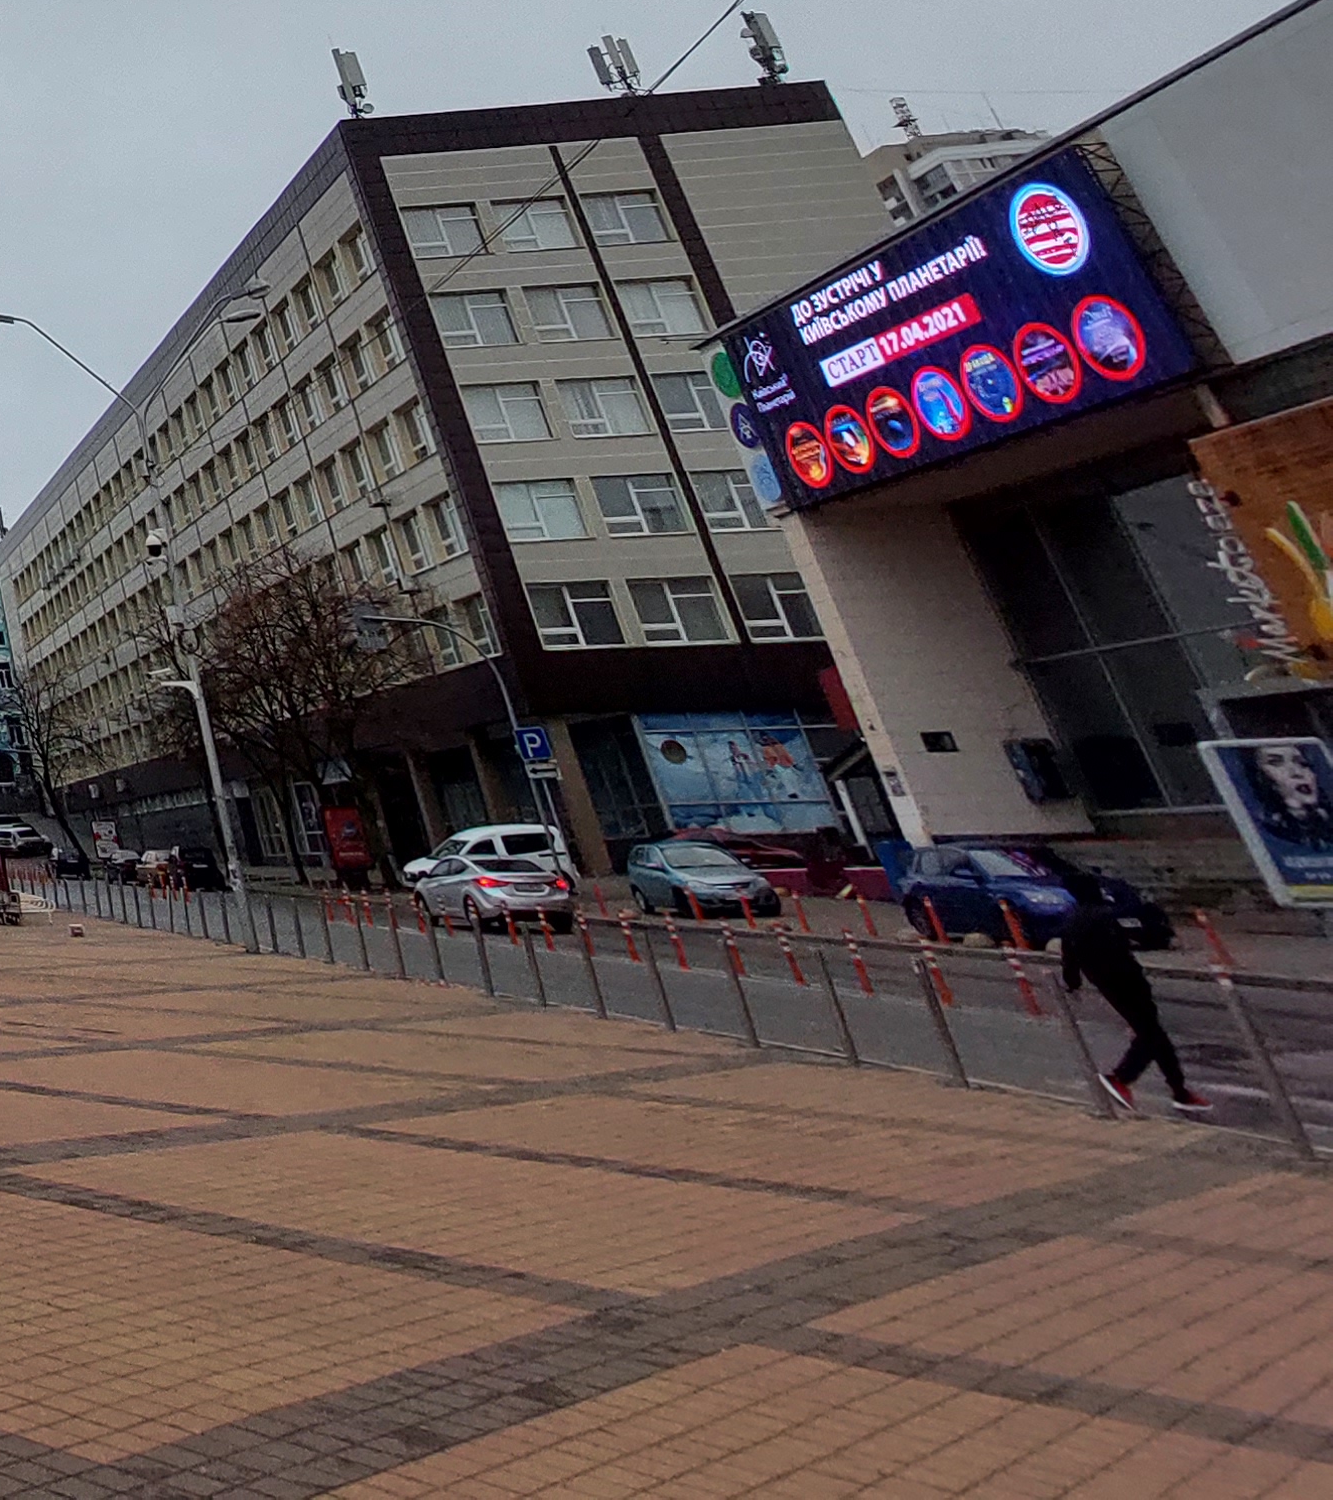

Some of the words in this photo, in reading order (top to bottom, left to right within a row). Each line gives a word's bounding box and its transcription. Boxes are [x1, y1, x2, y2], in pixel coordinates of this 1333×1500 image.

[790, 302, 812, 327] ДО
[809, 268, 874, 313] ЗУСТРІЧІ
[867, 260, 883, 282] У
[798, 287, 889, 346] КИЇВСЬКОМУ
[886, 235, 988, 302] ПЛАНЕТАРІЇ!
[826, 343, 881, 380] СТАРТ
[879, 301, 968, 357] 17.04.2021
[522, 732, 542, 758] P
